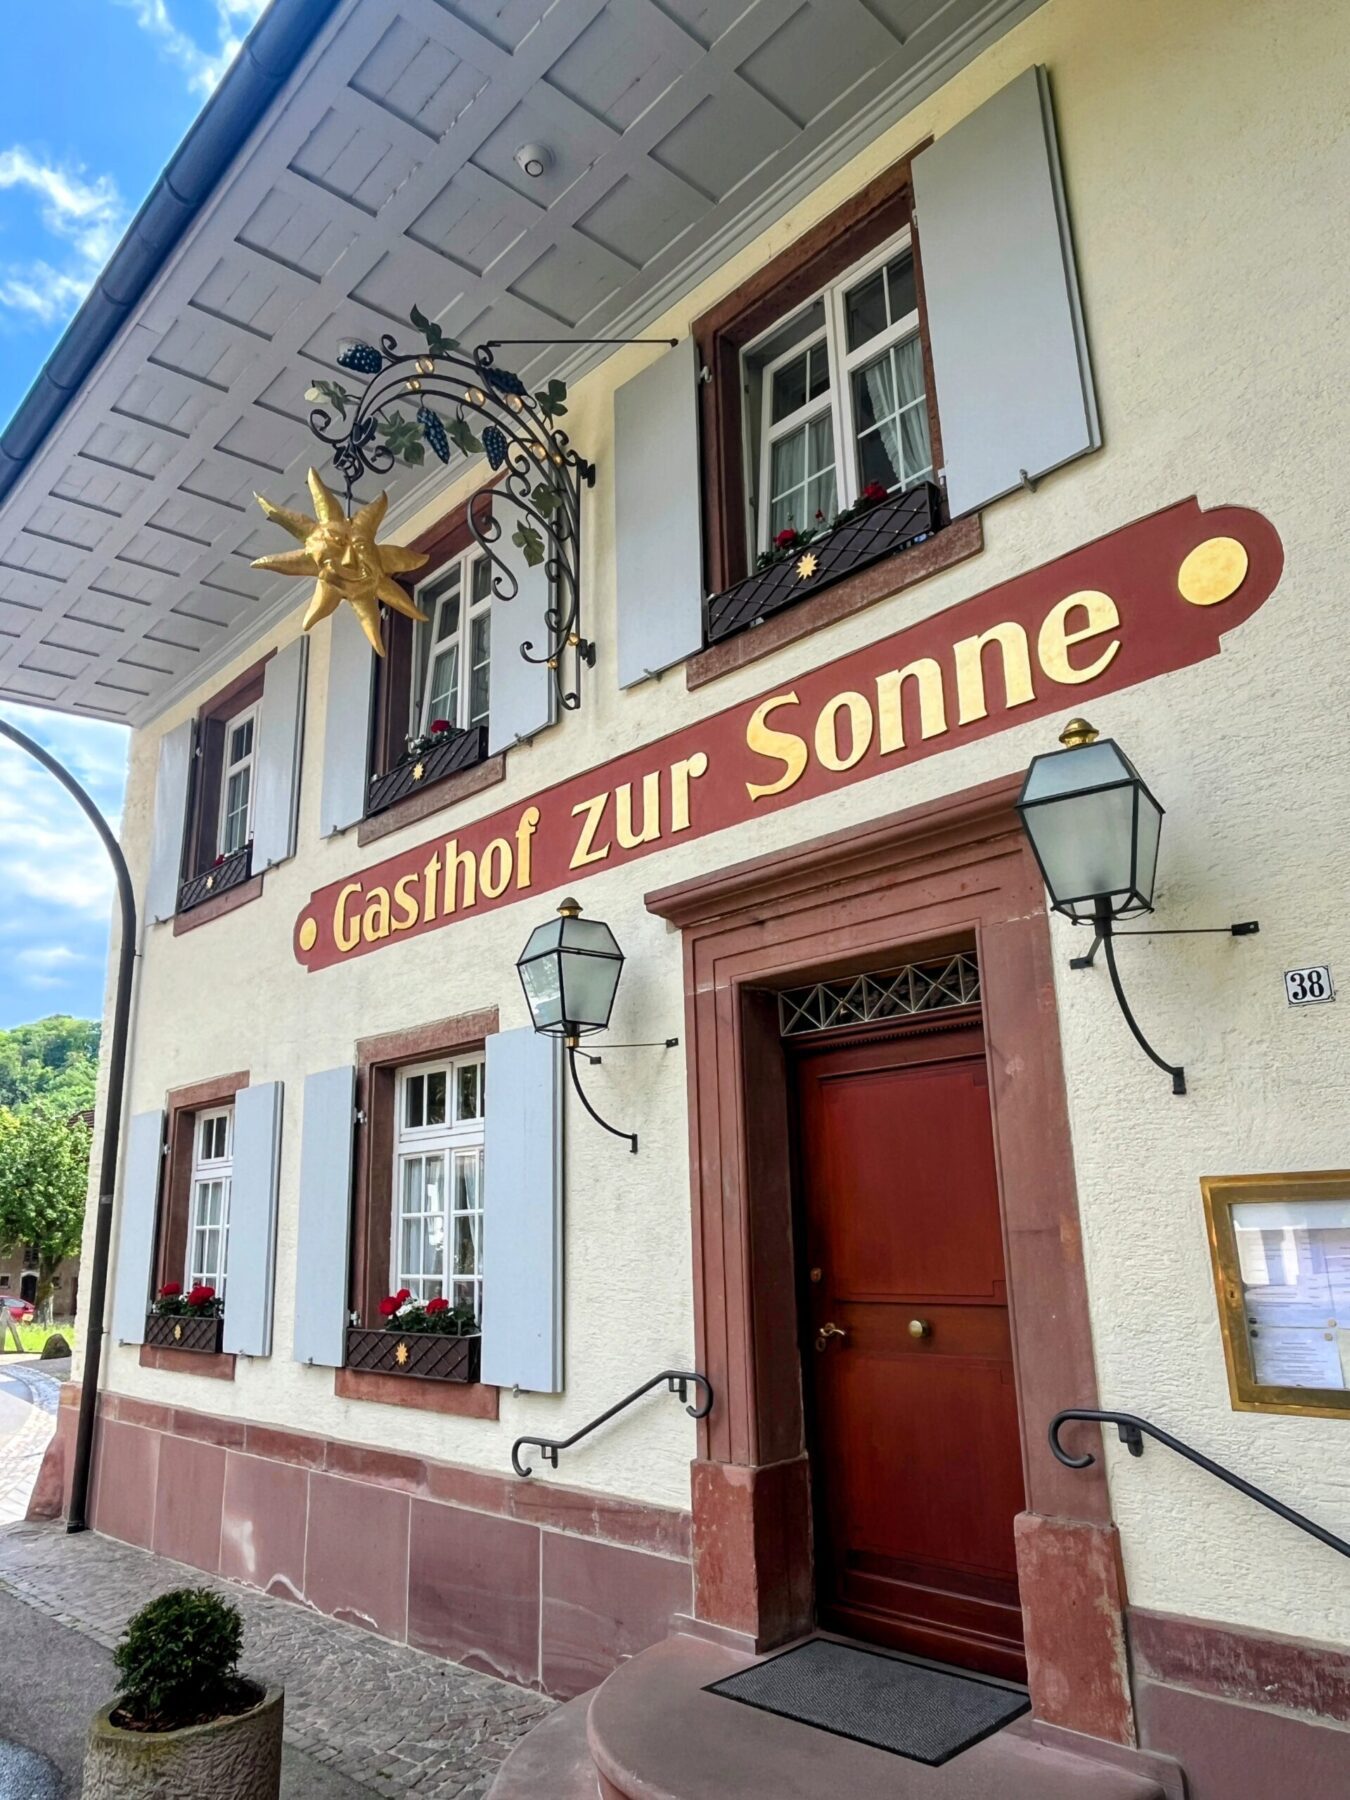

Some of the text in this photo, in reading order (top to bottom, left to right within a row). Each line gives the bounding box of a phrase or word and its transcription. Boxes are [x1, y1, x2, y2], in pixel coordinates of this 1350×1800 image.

[333, 589, 1121, 953] Gasthof zur Sonne
[1290, 970, 1324, 1000] 38
